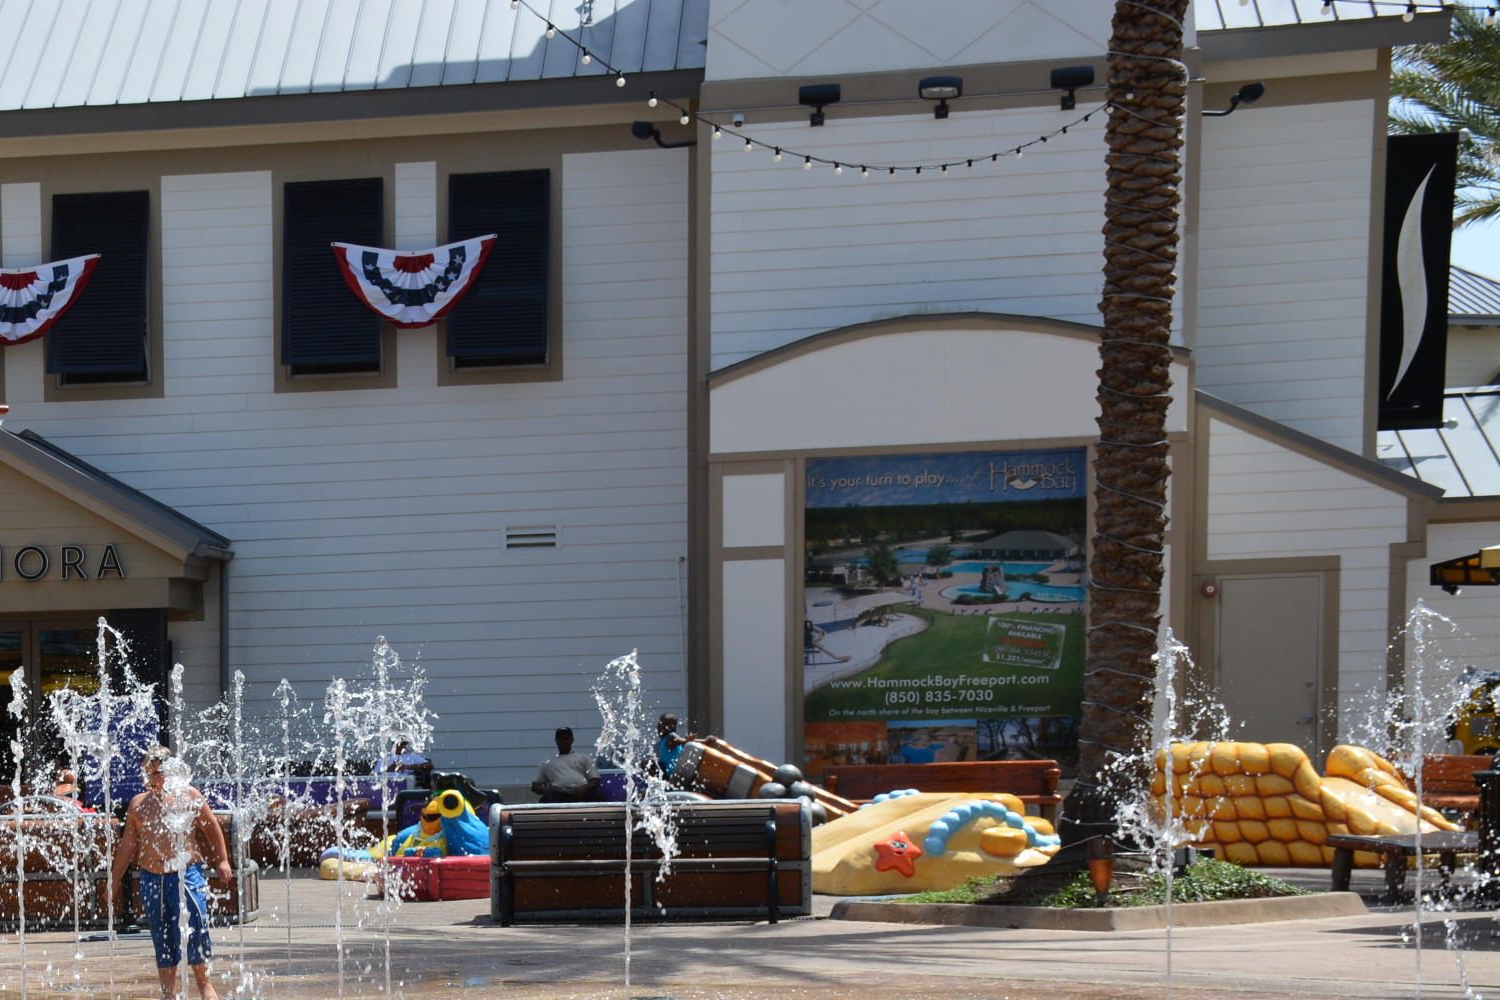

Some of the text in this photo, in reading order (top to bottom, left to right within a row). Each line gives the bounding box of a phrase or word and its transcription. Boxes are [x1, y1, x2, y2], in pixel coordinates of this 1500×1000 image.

[990, 456, 1075, 491] Hammock
[831, 477, 861, 492] your
[866, 474, 893, 487] turn
[898, 473, 911, 485] to
[1041, 473, 1077, 498] Bay
[830, 674, 1050, 689] www.HammockBayFreeport.com
[885, 689, 994, 705] (850) 835-7030
[1018, 704, 1051, 713] Freeport
